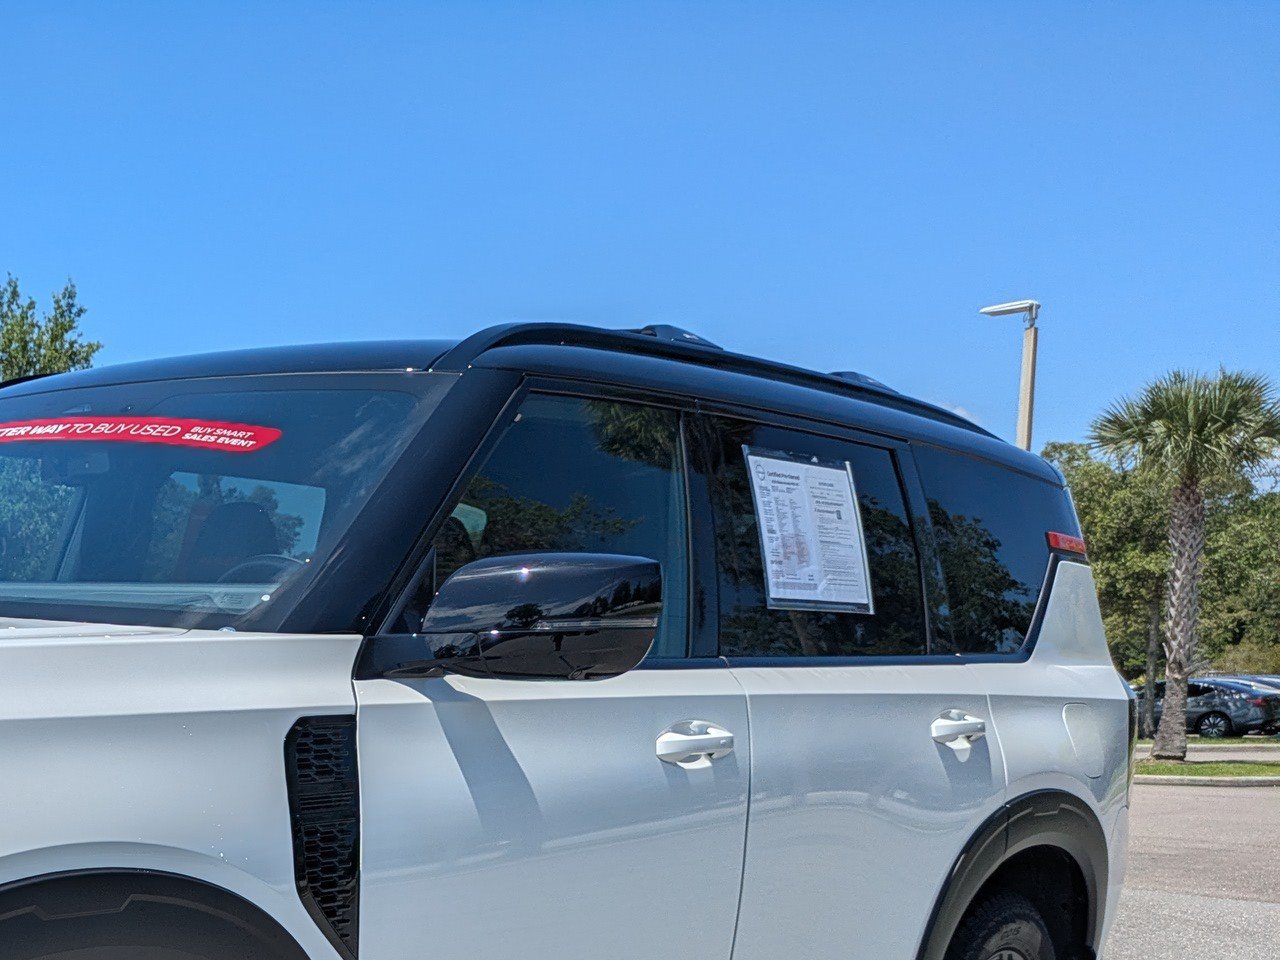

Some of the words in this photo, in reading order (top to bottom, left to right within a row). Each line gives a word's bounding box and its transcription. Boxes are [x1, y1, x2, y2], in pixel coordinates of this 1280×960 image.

[29, 424, 71, 435] WAY
[68, 423, 94, 434] TO
[91, 423, 134, 434] BUY
[130, 424, 181, 437] USED
[190, 426, 216, 434] BUY
[213, 428, 255, 439] SMART
[181, 433, 218, 443] SALES
[216, 436, 257, 448] EVENT
